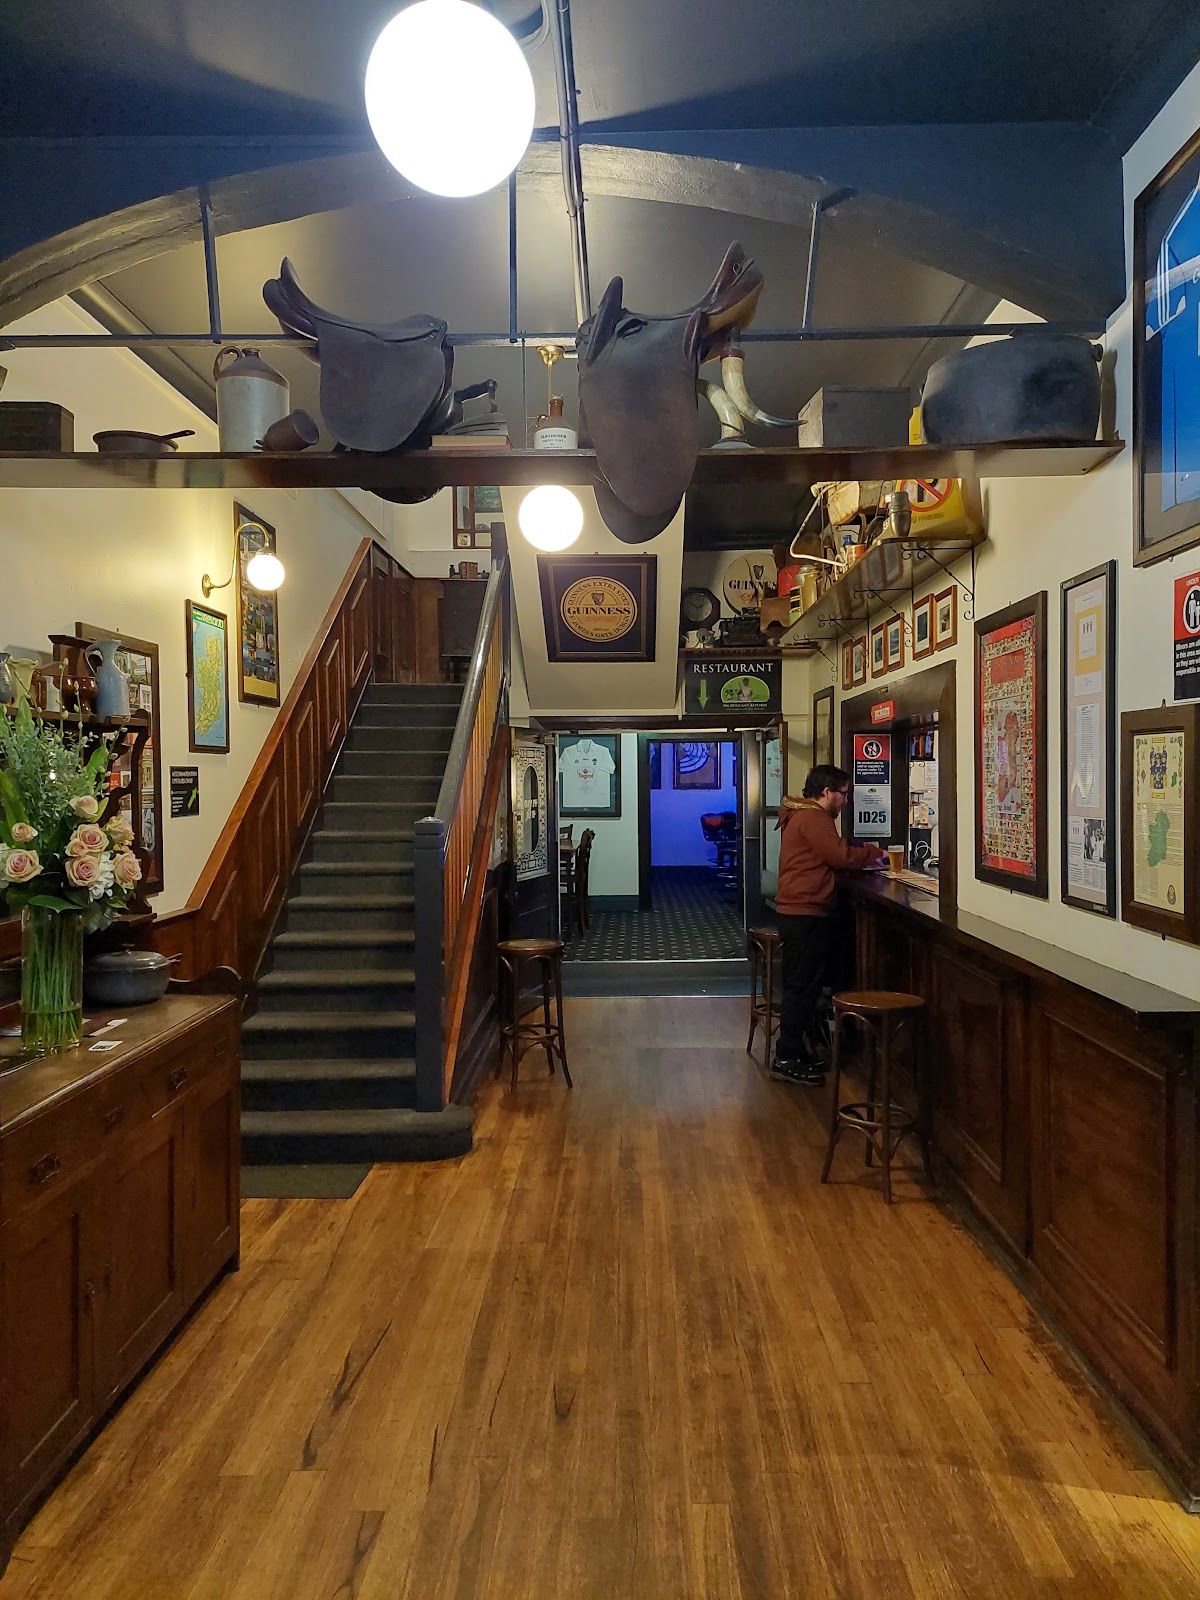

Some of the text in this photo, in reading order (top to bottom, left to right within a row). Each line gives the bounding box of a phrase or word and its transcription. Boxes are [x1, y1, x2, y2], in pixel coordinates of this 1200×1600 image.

[919, 512, 944, 521] PARKING
[728, 580, 777, 591] GUINNES
[1186, 577, 1199, 586] UNDER
[568, 581, 630, 606] GUINNESS EXTRA STOUT
[567, 606, 631, 615] GUINNESS
[614, 615, 630, 633] DUBLIN
[1176, 643, 1188, 651] Minors
[693, 663, 773, 673] RESTAURANT
[1180, 660, 1188, 668] they
[1176, 667, 1196, 676] responsible
[858, 811, 887, 824] ID25
